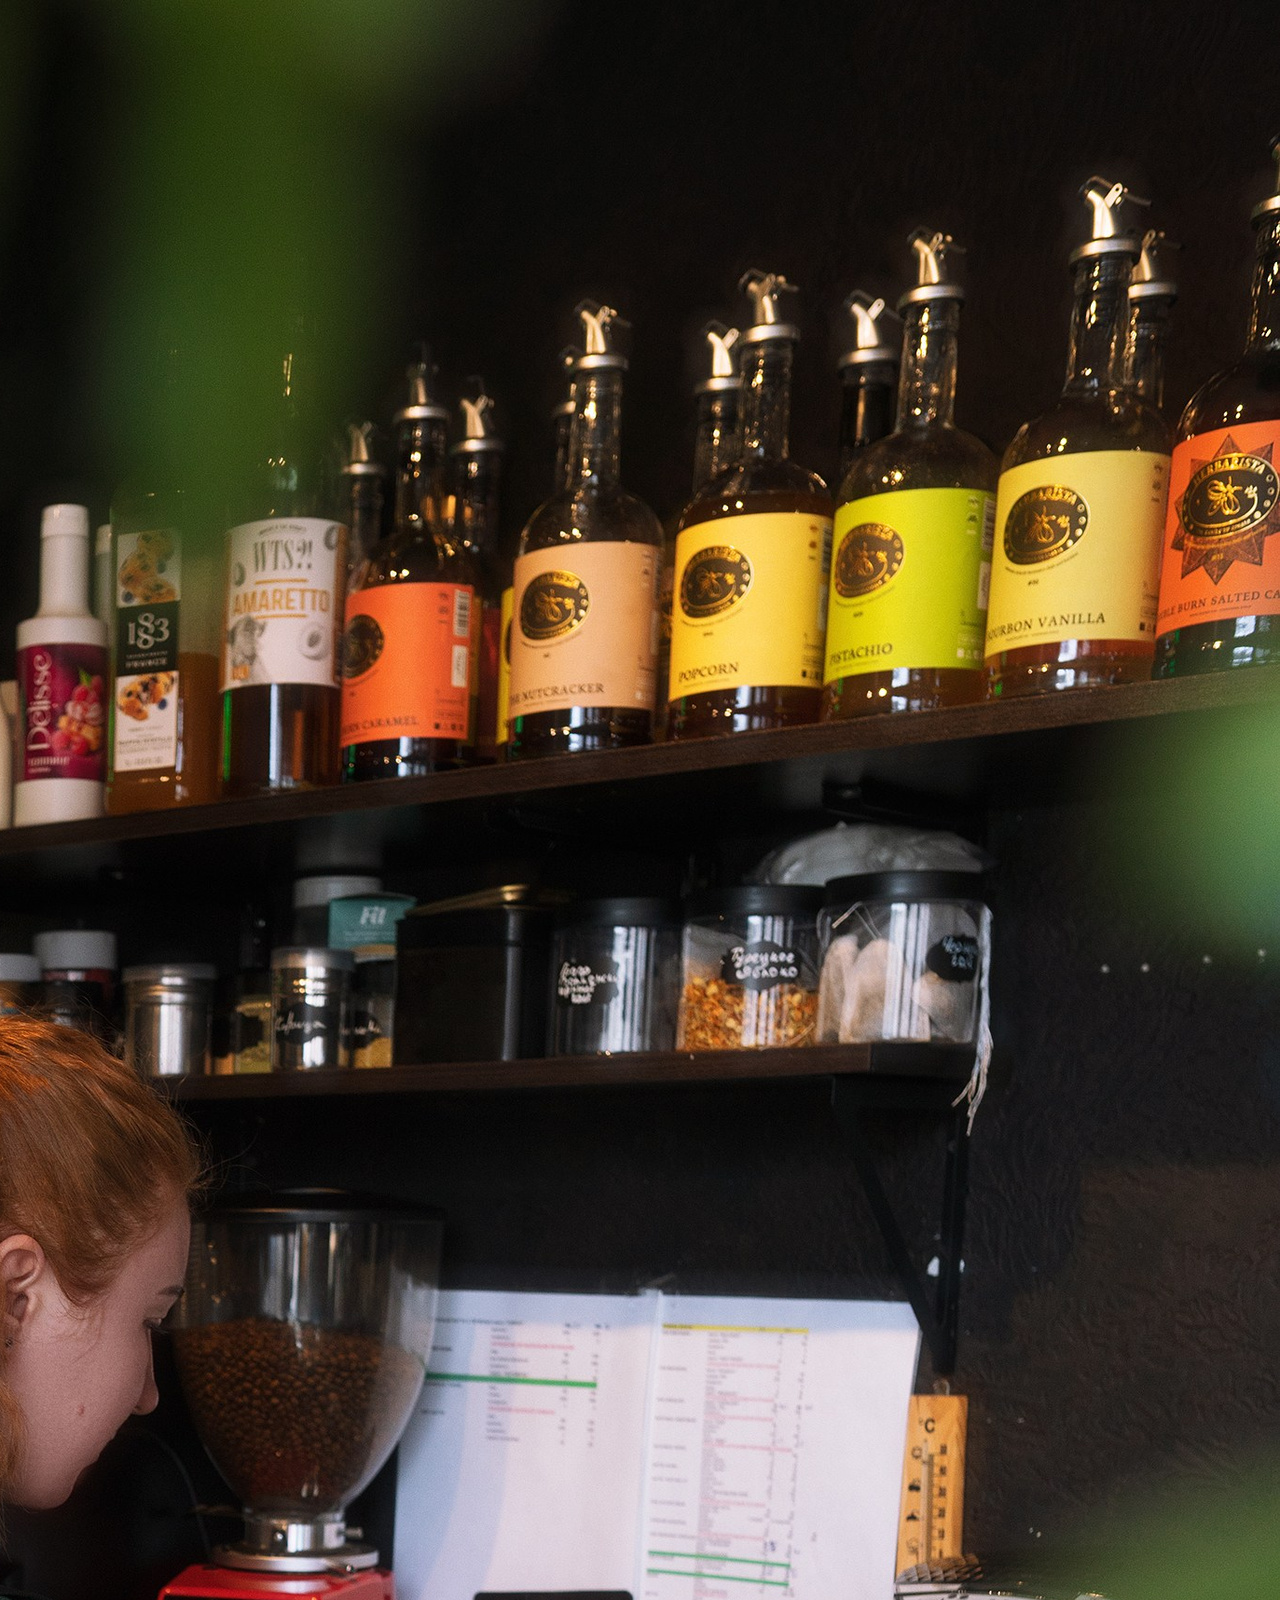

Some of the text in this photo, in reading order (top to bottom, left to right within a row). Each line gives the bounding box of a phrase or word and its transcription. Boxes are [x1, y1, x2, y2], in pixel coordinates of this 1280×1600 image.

[233, 587, 330, 615] AMARETTO
[1177, 598, 1208, 613] BURN
[1210, 590, 1261, 606] SALTED
[987, 619, 1033, 641] OURBON
[1038, 612, 1106, 628] VANILLA
[678, 661, 739, 683] POPCORN
[362, 715, 418, 730] CARAMEL
